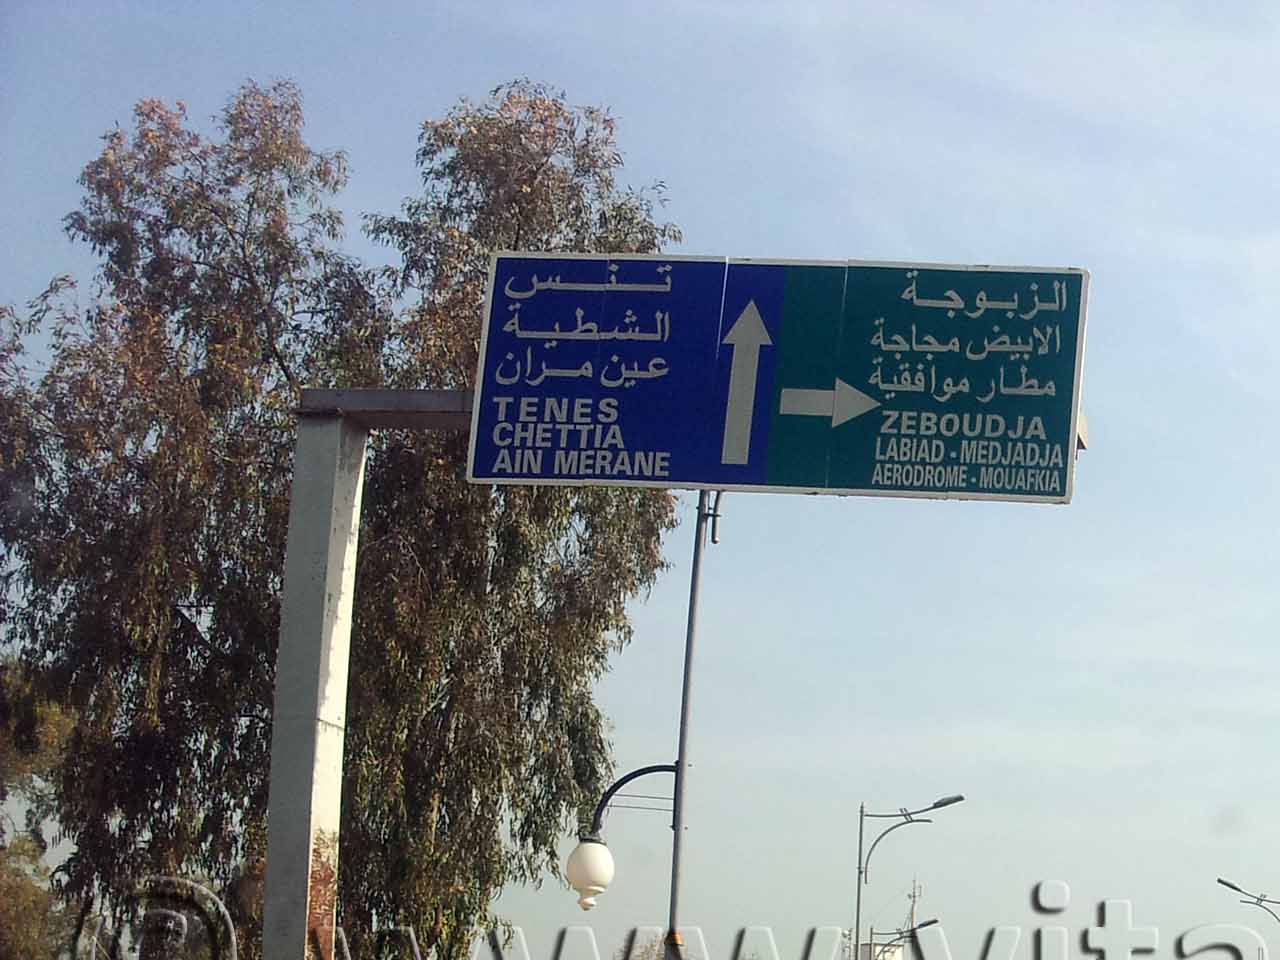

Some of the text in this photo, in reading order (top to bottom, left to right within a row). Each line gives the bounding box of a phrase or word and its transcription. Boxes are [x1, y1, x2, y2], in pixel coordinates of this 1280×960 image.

[504, 264, 672, 299] تنس
[901, 270, 1067, 320] الزبوجة
[502, 302, 672, 348] الشطية
[870, 317, 960, 360] مجاجة
[495, 346, 670, 388] عين مران
[976, 364, 1056, 403] مطار
[493, 397, 619, 423] TENES
[880, 410, 1047, 440] ZEBOUDJA
[492, 422, 625, 449] CHETTIA
[492, 448, 671, 477] AIN MERANE
[875, 437, 945, 463] LABIAD
[960, 440, 1063, 468] MEDJADJA
[872, 464, 968, 488] AERODROME
[979, 467, 1061, 492] MOUAFKIA
